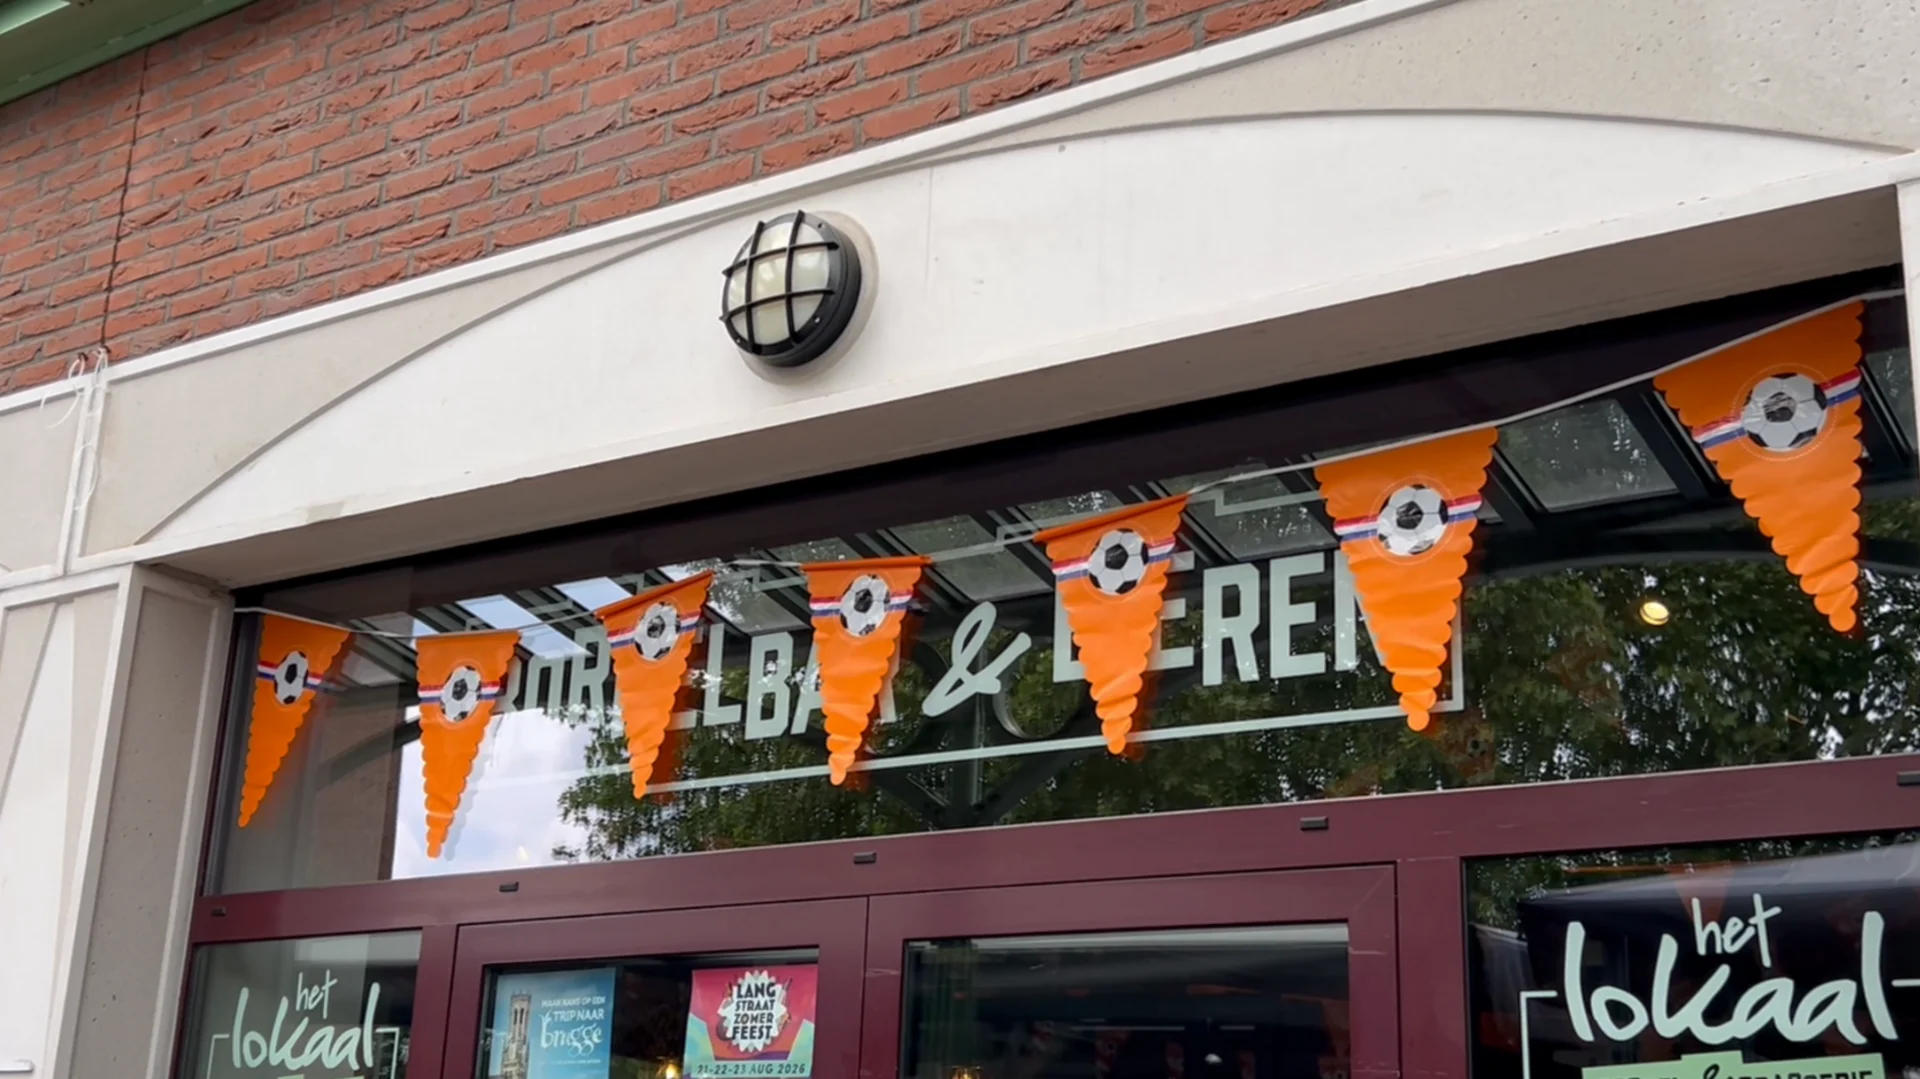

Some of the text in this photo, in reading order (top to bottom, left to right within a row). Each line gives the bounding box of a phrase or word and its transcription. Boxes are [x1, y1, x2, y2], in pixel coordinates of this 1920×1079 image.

[921, 600, 1032, 717] &
[1691, 893, 1782, 968] het
[1564, 911, 1899, 1045] lokaal
[296, 969, 338, 1020] het
[736, 982, 777, 999] LANG
[735, 999, 776, 1012] STRAAT
[553, 1008, 605, 1022] TRIP NAAR
[733, 1012, 775, 1025] ZOMER
[232, 982, 381, 1071] lokaal
[731, 1025, 773, 1040] FEEST
[749, 1064, 773, 1074] AUG
[777, 1063, 806, 1074] 2026
